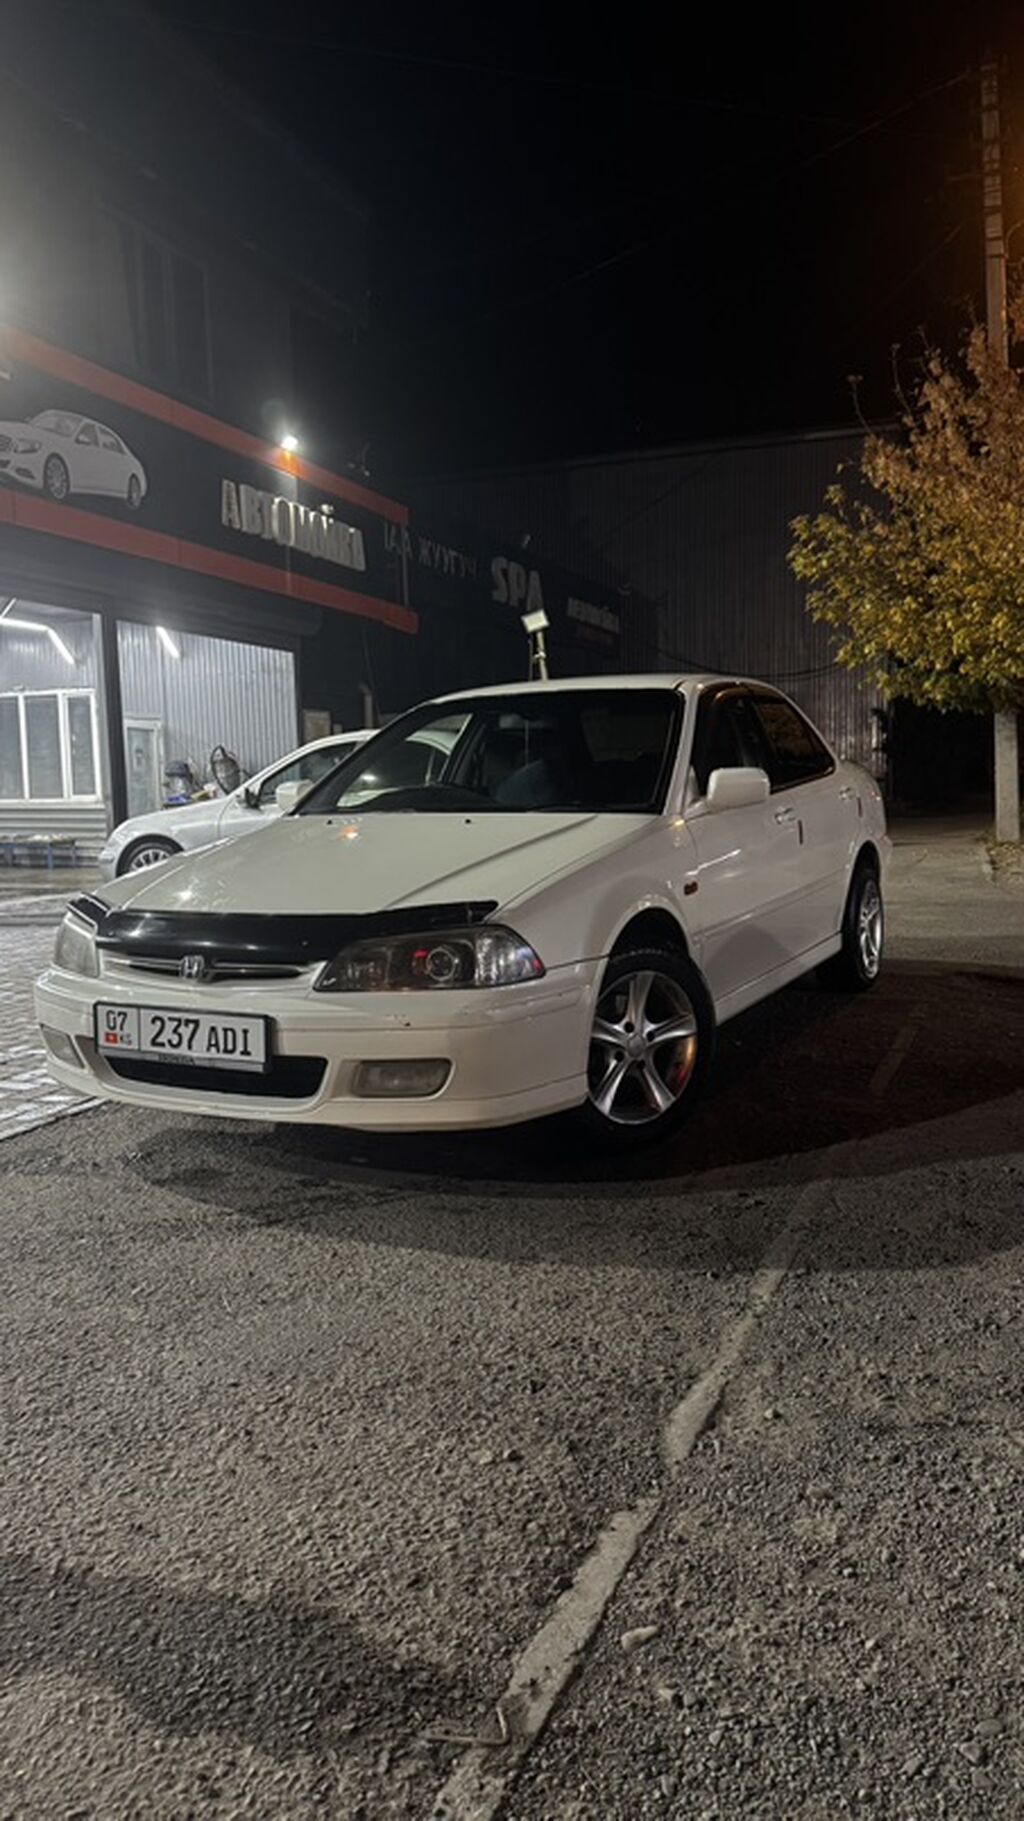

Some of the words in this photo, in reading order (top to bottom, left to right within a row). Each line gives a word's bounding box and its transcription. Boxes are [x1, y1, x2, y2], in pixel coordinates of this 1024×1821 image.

[492, 556, 545, 611] SPA
[106, 1010, 128, 1031] 07
[150, 1016, 200, 1050] 237
[206, 1026, 252, 1056] ADI
